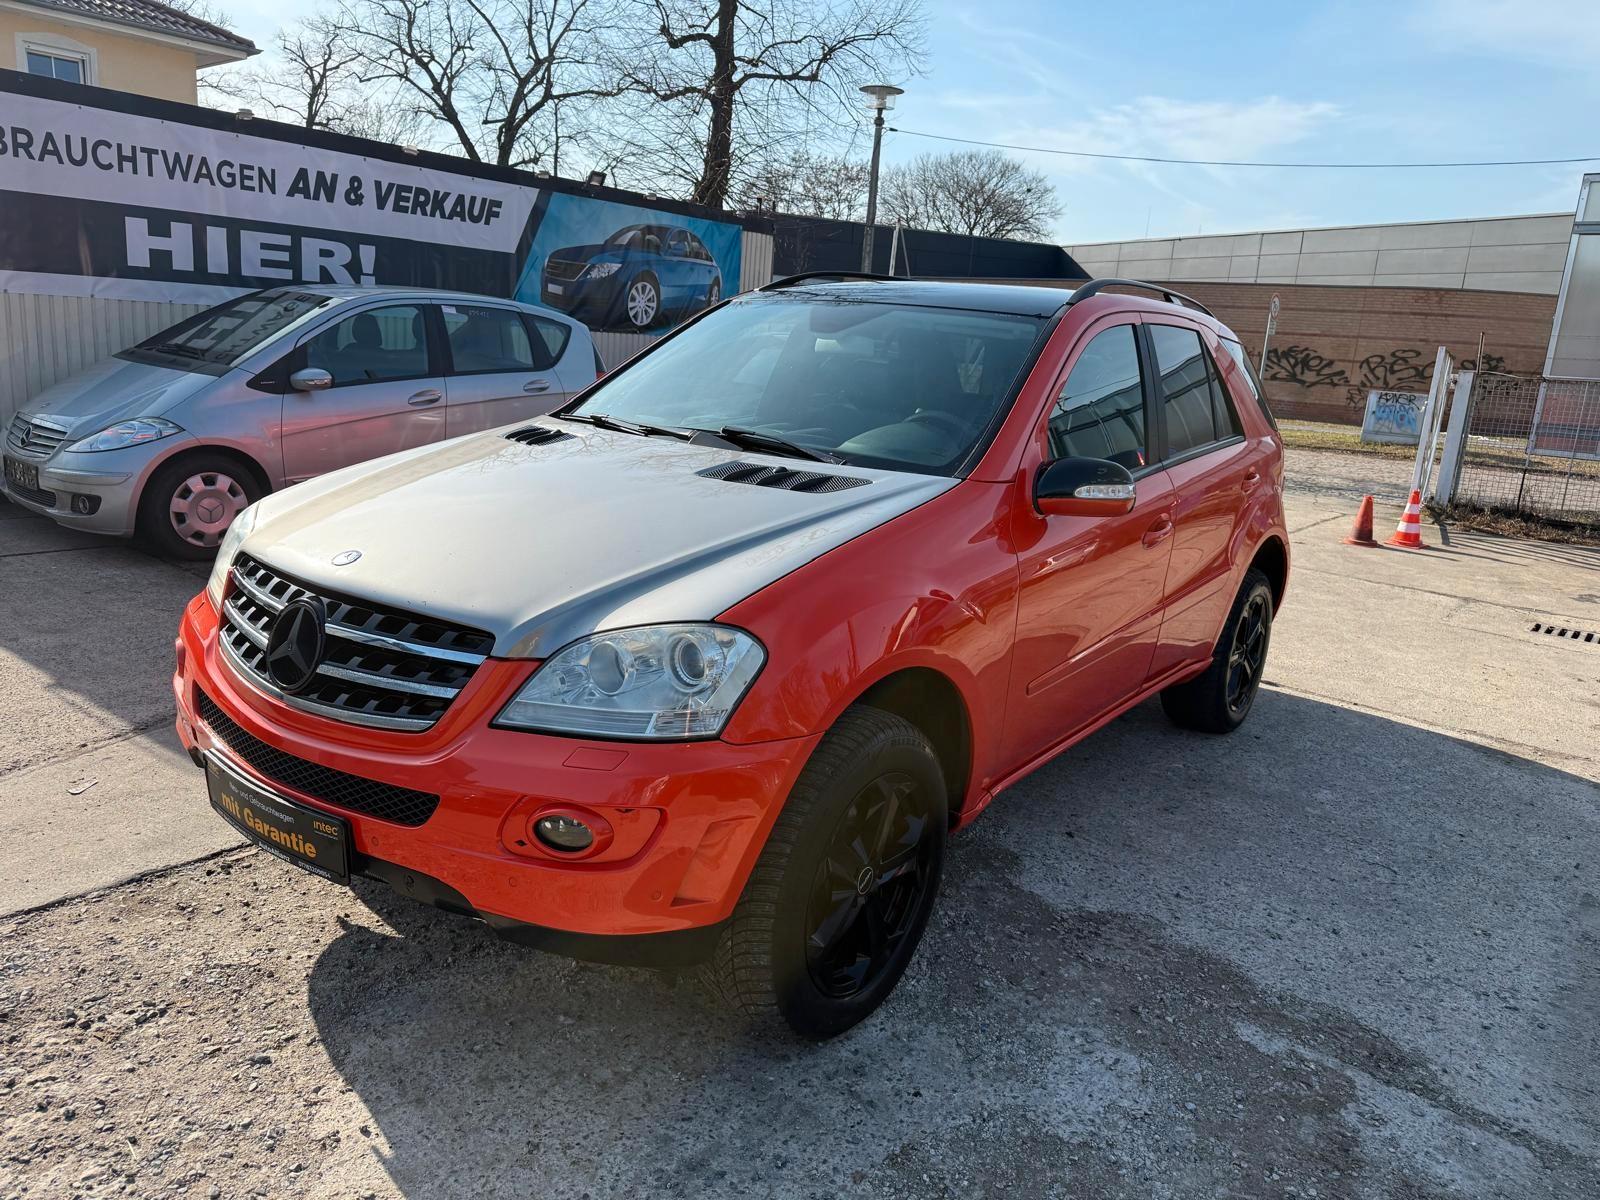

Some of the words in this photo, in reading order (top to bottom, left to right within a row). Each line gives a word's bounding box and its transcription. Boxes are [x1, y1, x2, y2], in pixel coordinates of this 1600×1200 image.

[286, 167, 339, 203] AN
[344, 175, 365, 207] &
[374, 180, 502, 226] VERKAUF
[124, 216, 376, 286] HIER!
[222, 792, 240, 819] mit
[244, 808, 317, 858] Garantie
